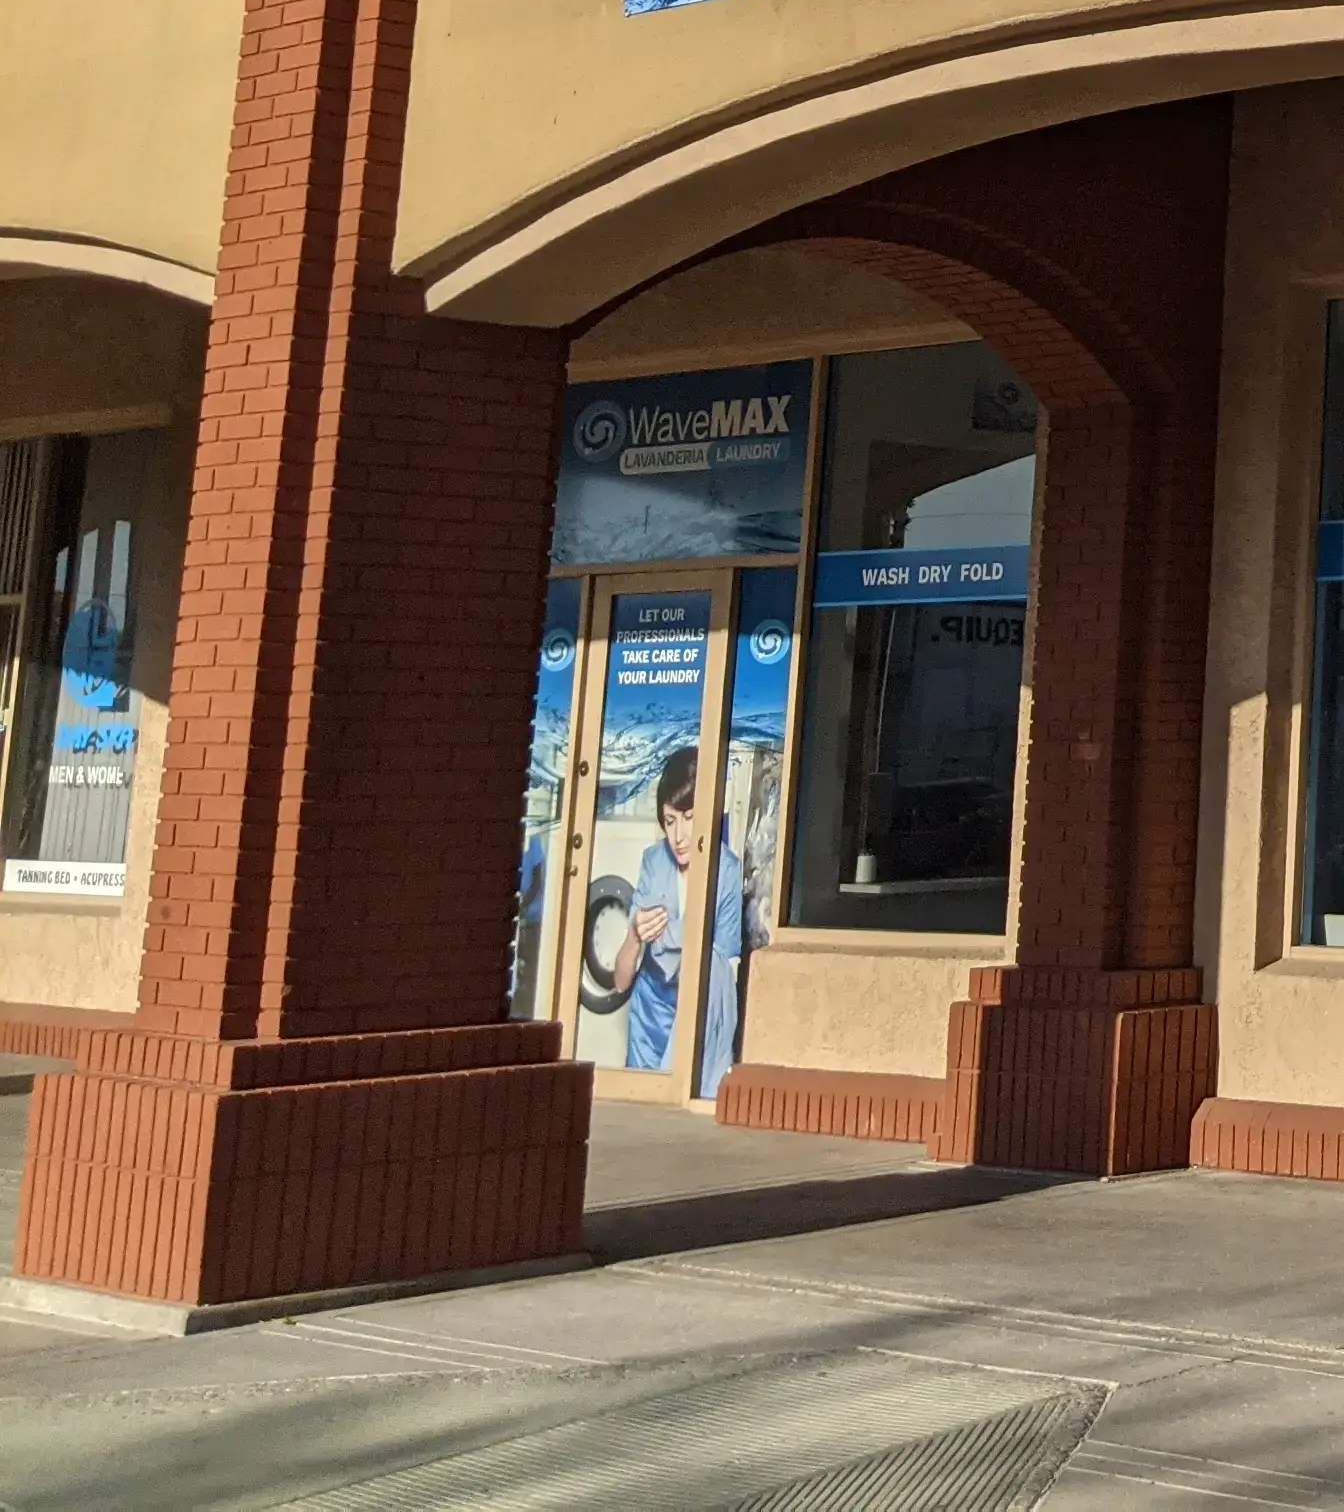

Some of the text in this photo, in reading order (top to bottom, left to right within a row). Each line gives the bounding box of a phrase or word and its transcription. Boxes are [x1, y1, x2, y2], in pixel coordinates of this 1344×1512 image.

[630, 394, 792, 445] WaveMAX
[625, 441, 781, 469] LAVANDERIA LAUNDRY
[862, 562, 1004, 586] WASH DRY FOLD
[639, 608, 685, 623] LET OUR
[616, 628, 705, 644] PROFESSIONALS
[622, 648, 699, 664] TAKE CARE OF
[618, 669, 700, 685] YOUR LAUNDRY
[49, 765, 74, 784] MEN
[76, 765, 85, 784] &
[17, 869, 53, 884] TANNING
[55, 870, 71, 885] BED
